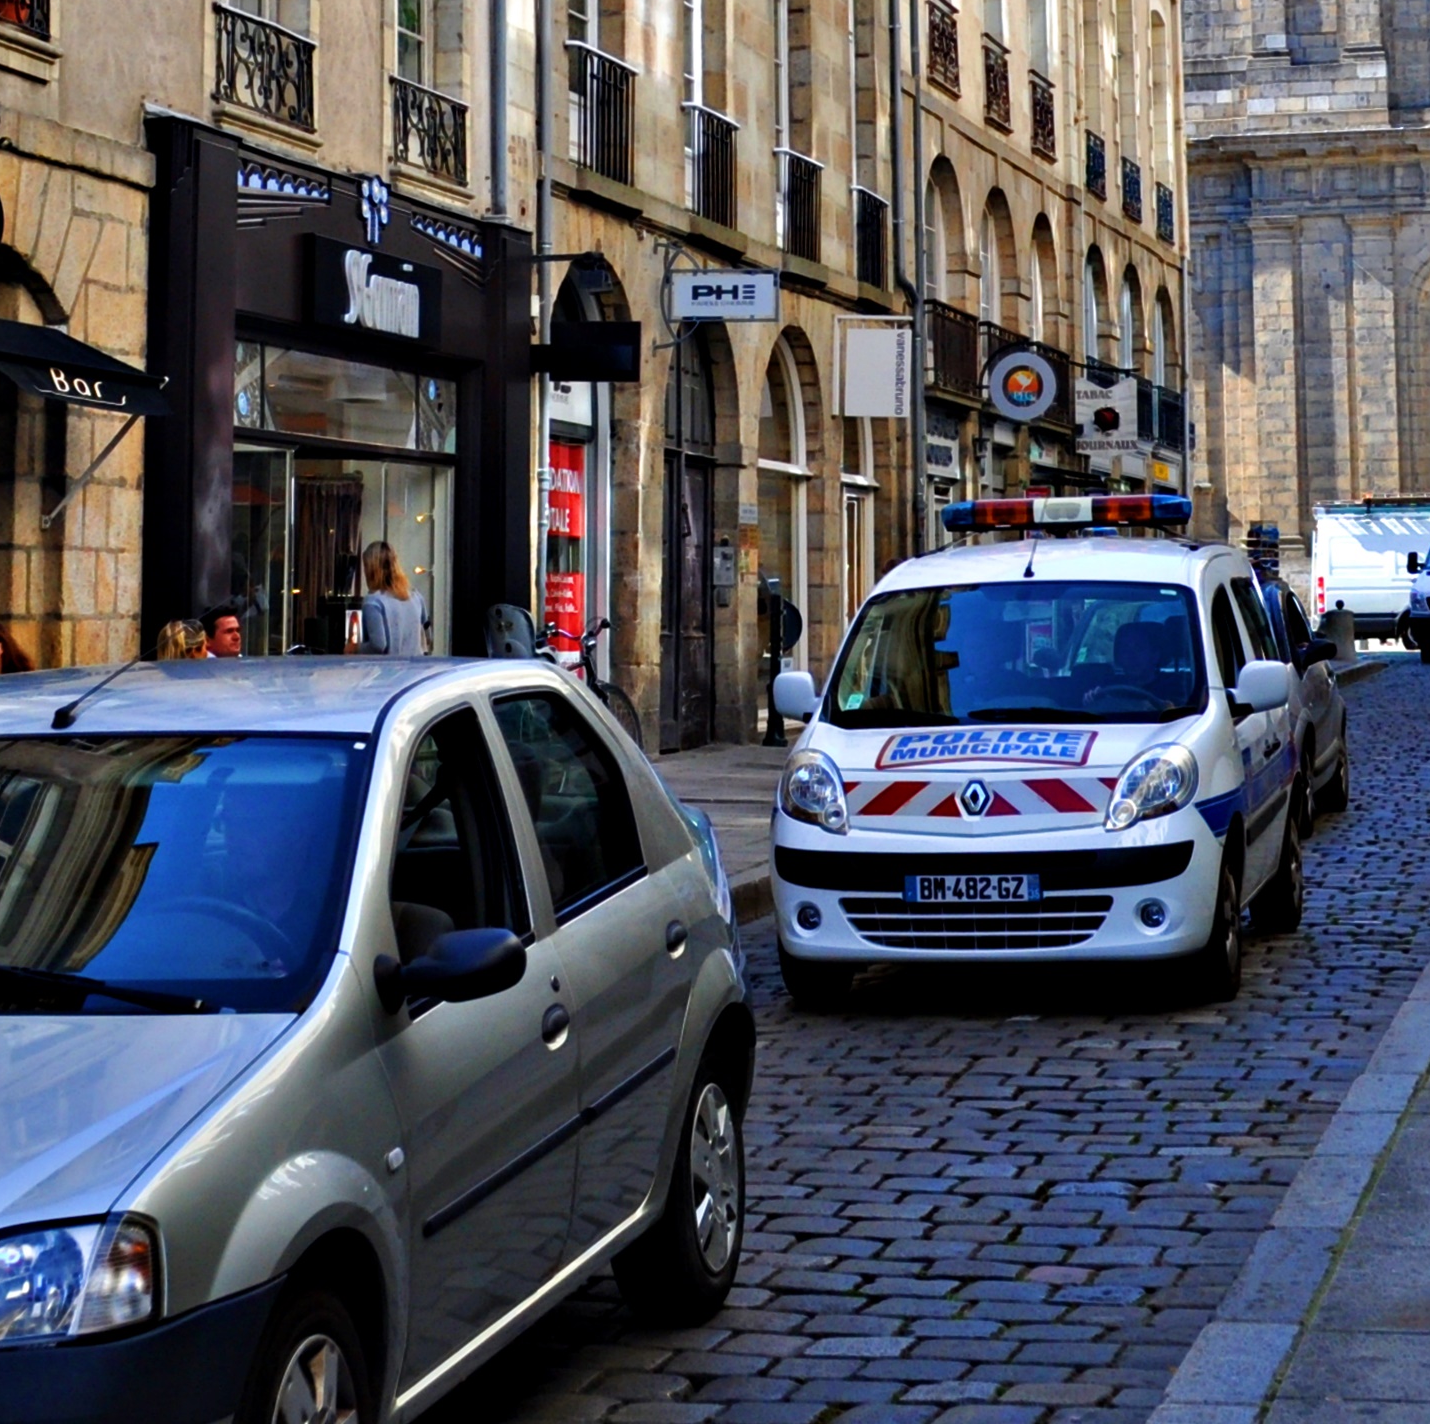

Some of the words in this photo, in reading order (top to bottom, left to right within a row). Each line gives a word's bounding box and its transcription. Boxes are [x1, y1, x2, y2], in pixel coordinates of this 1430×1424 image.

[692, 284, 755, 301] PHE
[50, 367, 102, 398] Bar
[1076, 390, 1112, 400] TABAC
[1075, 439, 1138, 451] JOURNAUX
[896, 731, 1084, 748] POLICE
[890, 742, 1078, 761] MUNICIPALE
[919, 876, 1025, 901] BM-482-GZ
